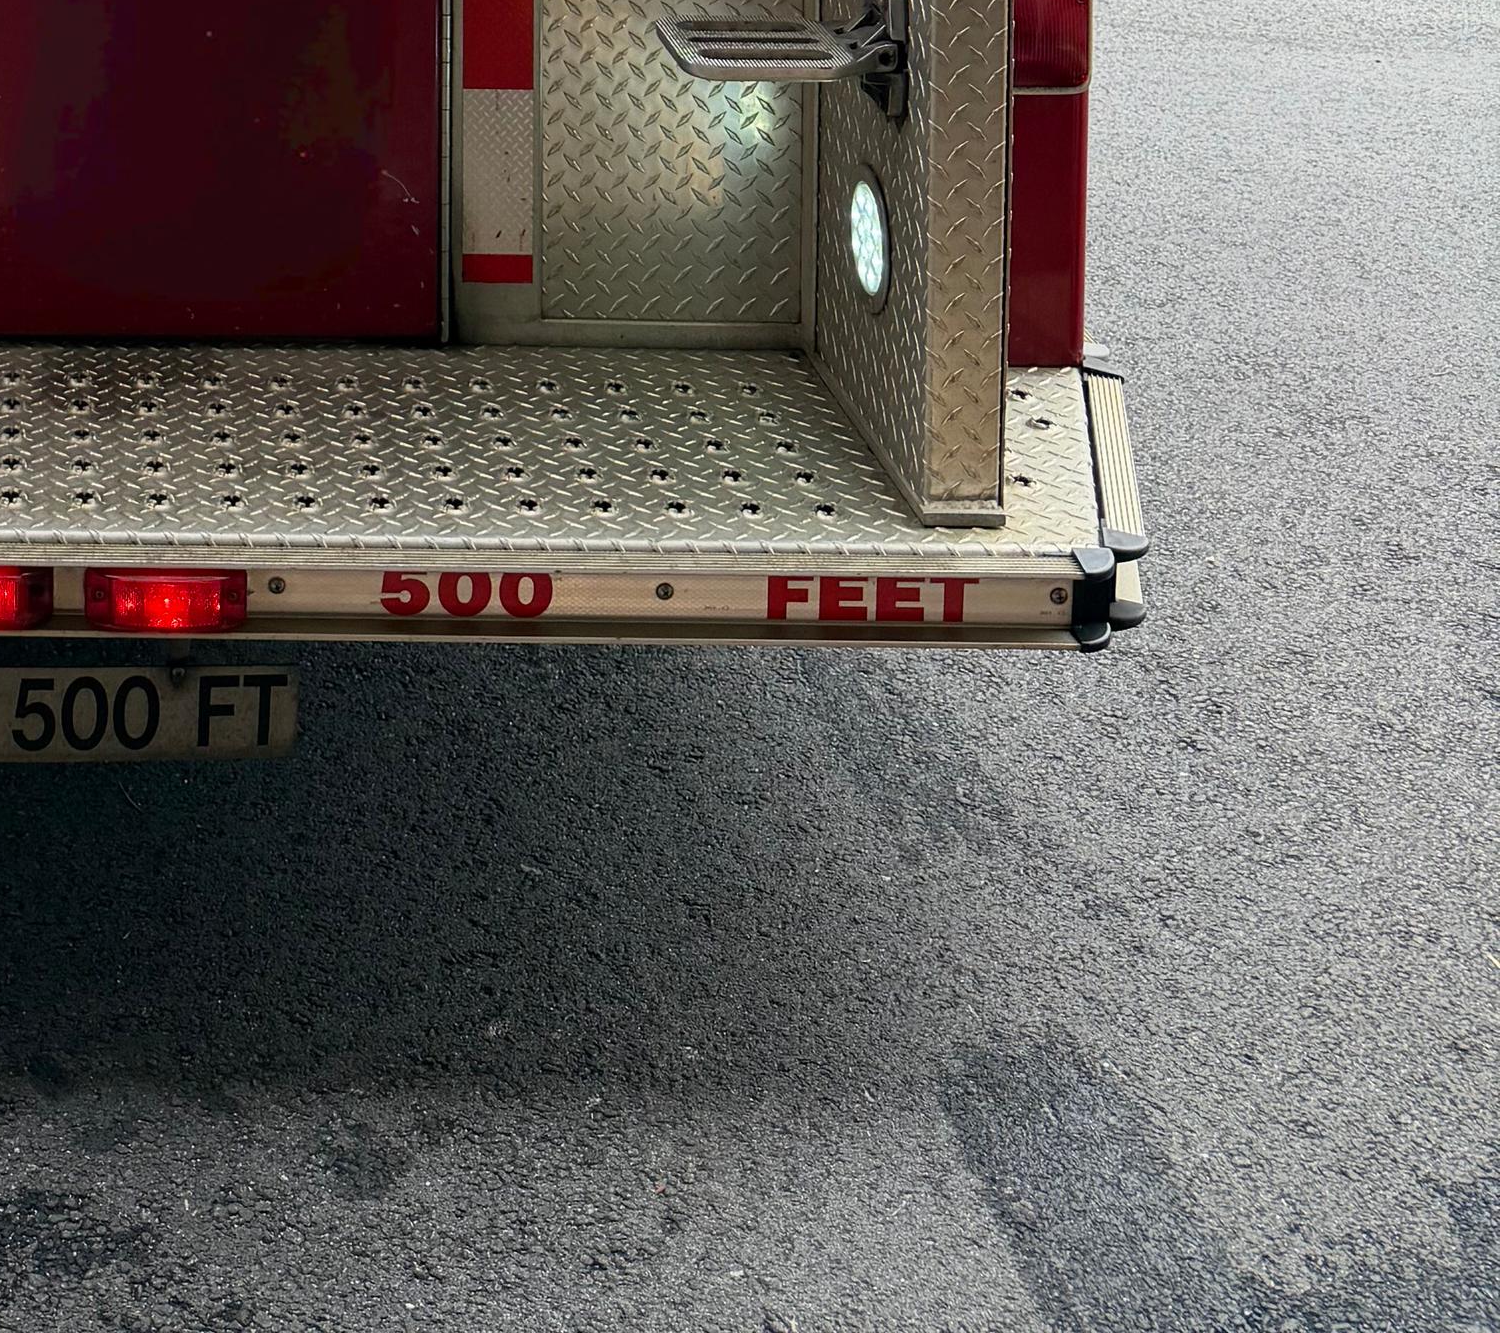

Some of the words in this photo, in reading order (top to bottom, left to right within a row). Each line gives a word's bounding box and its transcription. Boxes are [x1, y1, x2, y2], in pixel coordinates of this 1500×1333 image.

[379, 571, 553, 617] 500
[766, 575, 980, 623] FEET
[12, 675, 160, 751] 500
[198, 673, 288, 747] FT
